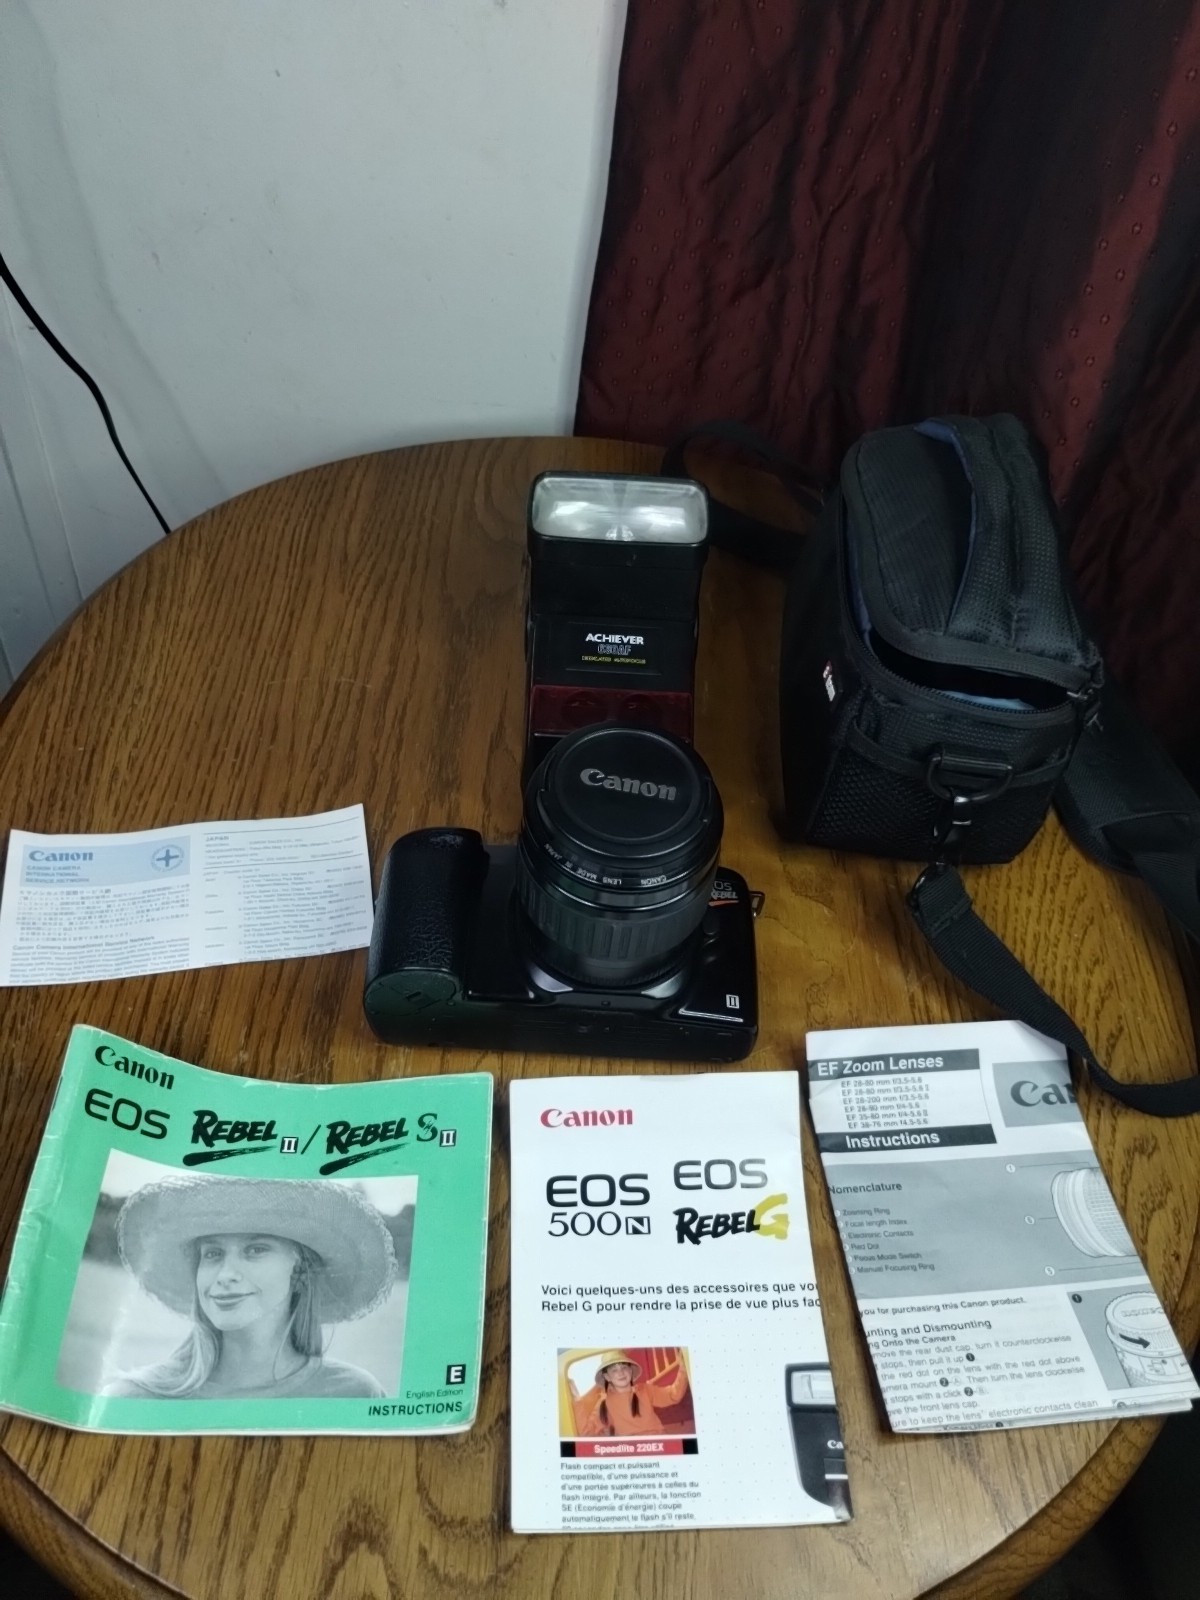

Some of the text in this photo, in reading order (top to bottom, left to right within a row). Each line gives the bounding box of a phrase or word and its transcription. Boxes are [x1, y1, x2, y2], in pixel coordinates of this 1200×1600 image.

[585, 633, 644, 645] ACHIEVER
[580, 768, 677, 801] Canon
[28, 850, 94, 862] Canon
[576, 867, 598, 880] MADE
[602, 876, 622, 885] LENS
[640, 875, 667, 886] CANON
[713, 880, 733, 891] OS
[95, 1045, 175, 1091] Canon
[817, 1054, 944, 1077] EF Zoom Lenses
[841, 1080, 851, 1088] EF
[843, 1097, 853, 1105] EF
[845, 1105, 855, 1113] EF
[84, 1088, 171, 1140] EOS
[190, 1109, 278, 1148] REBEL
[326, 1117, 409, 1155] REBEL
[540, 1108, 633, 1128] Canon
[846, 1113, 856, 1121] EF
[848, 1122, 858, 1130] EF
[845, 1131, 941, 1149] Instructions
[673, 1158, 768, 1190] EOS
[546, 1173, 651, 1208] EOS
[828, 1183, 903, 1195] Nomenclature
[873, 1207, 891, 1216] Ring
[918, 1262, 936, 1272] Ring
[541, 1284, 572, 1296] Voici
[575, 1283, 663, 1298] quelques-uns
[666, 1283, 690, 1295] des
[693, 1281, 769, 1294] accessoires
[772, 1282, 796, 1295] que
[541, 1297, 800, 1314] Rebel G pour rendre la prise de vue plus
[876, 1306, 889, 1314] for
[891, 1303, 941, 1316] purchasing
[941, 1301, 959, 1311] this
[960, 1299, 989, 1309] Canon
[900, 1319, 993, 1336] and Dismounting
[881, 1334, 957, 1348] Onto the Camera
[448, 1365, 464, 1383] E
[406, 1389, 464, 1400] English Edition
[368, 1401, 463, 1416] INSTRUCTIONS
[988, 1407, 1032, 1419] electronic
[1034, 1402, 1072, 1414] contacts
[1073, 1399, 1099, 1410] clean
[594, 1442, 664, 1455] Speedlite 220EX
[560, 1461, 660, 1472] Flash compact puissant
[630, 1471, 669, 1480] puissance
[688, 1480, 699, 1488] du
